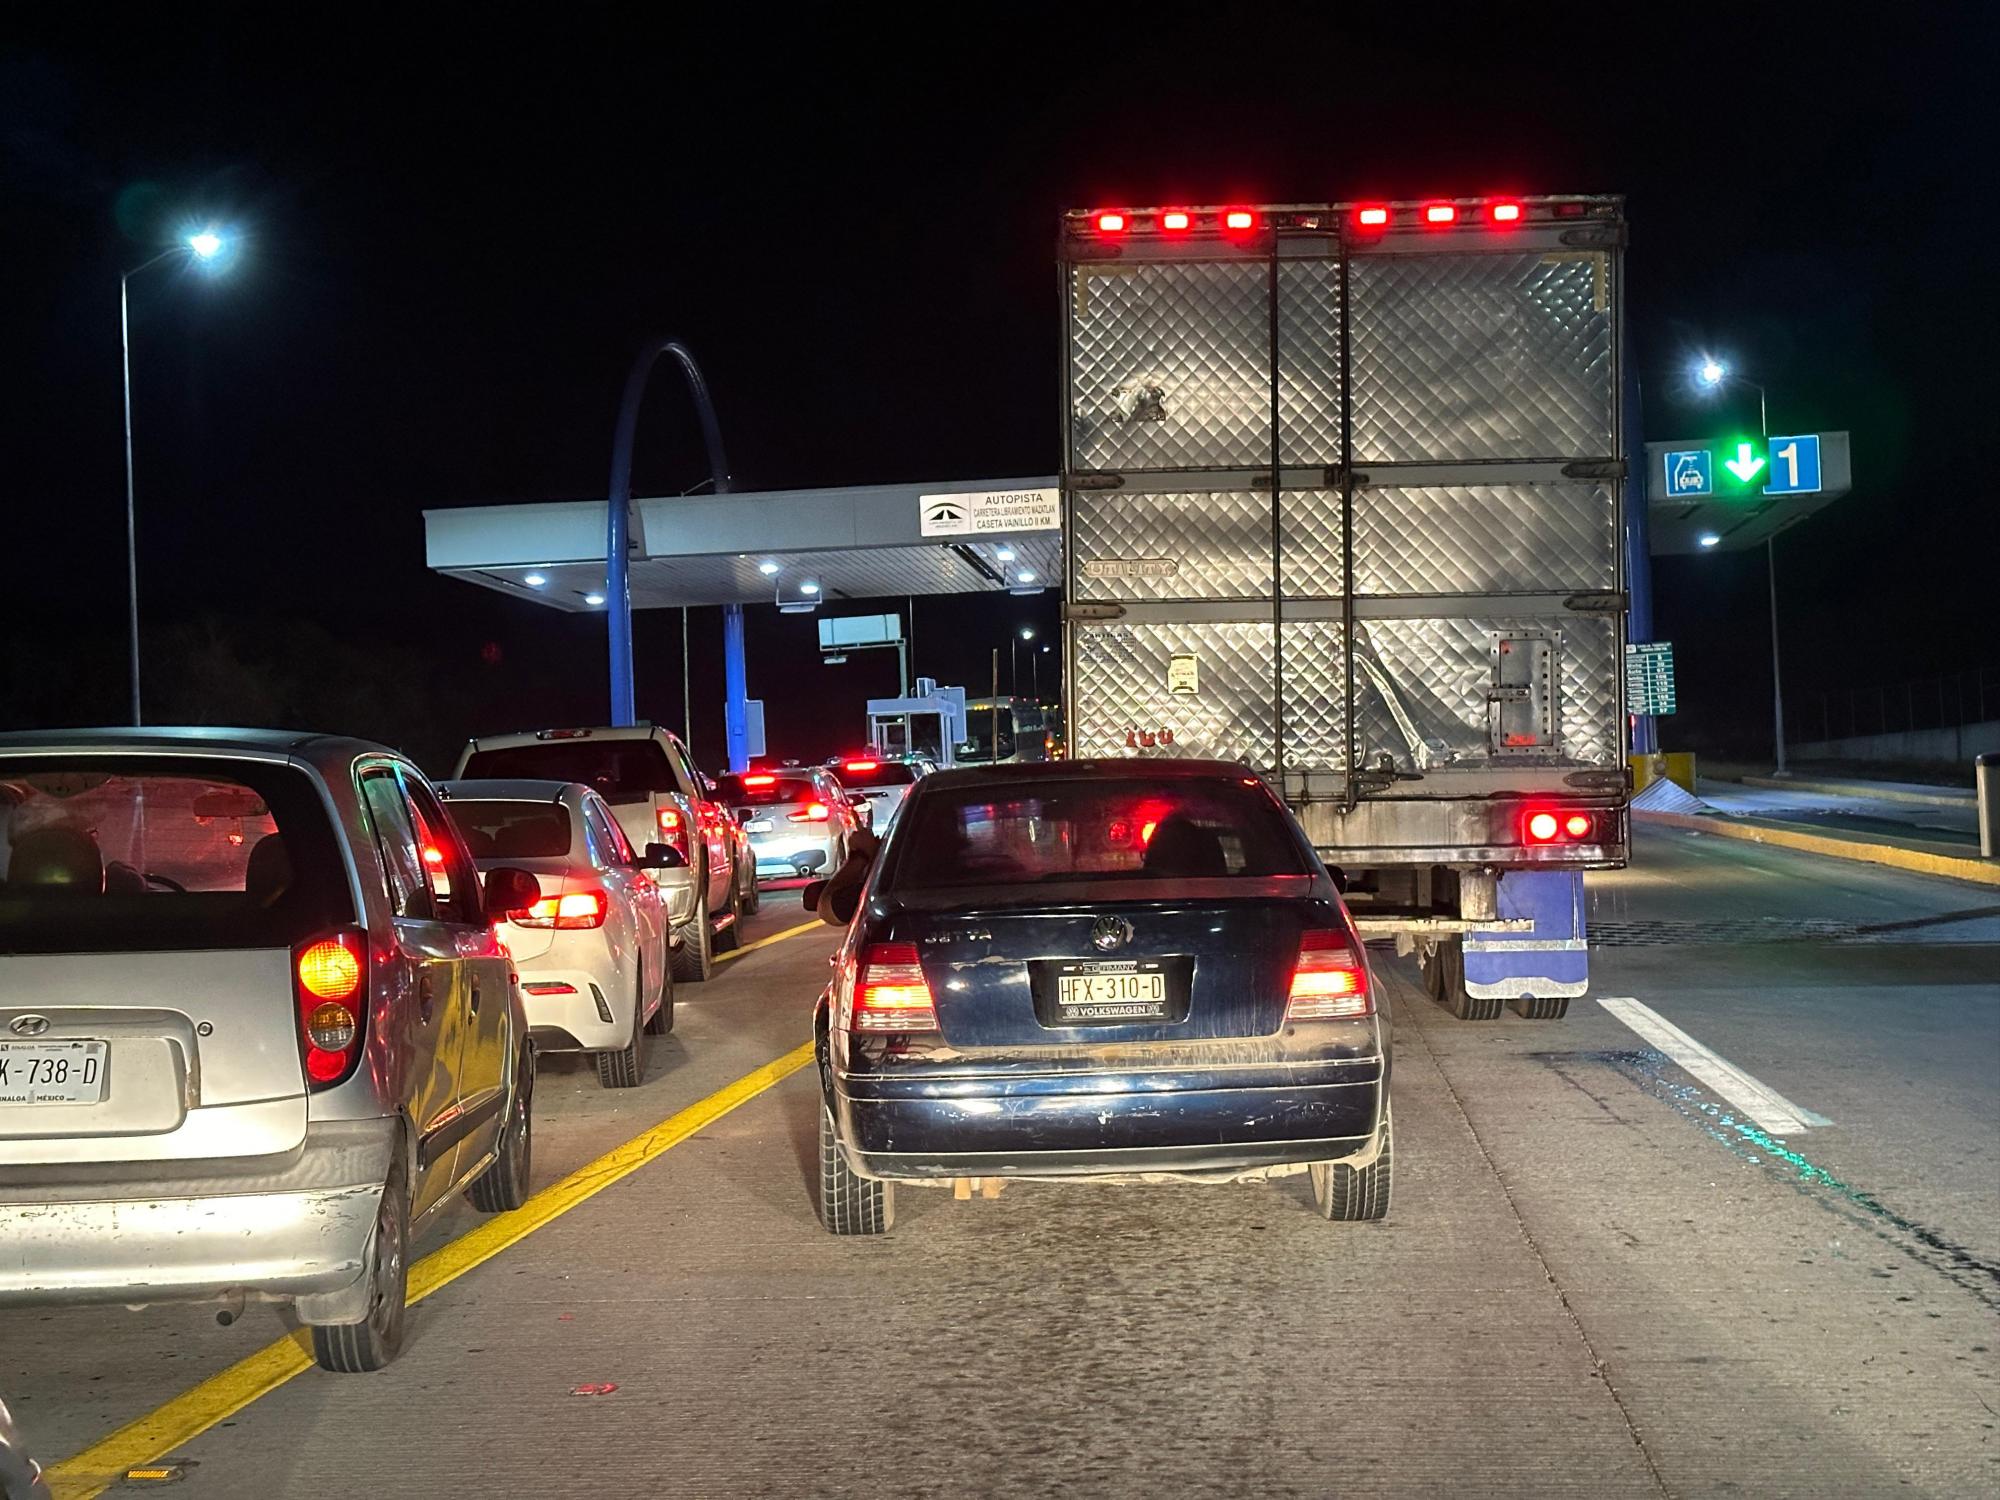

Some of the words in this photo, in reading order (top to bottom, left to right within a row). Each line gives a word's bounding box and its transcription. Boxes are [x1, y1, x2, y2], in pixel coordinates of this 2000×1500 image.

[1778, 442, 1799, 487] 1
[985, 493, 1043, 505] AUTOPISTA
[976, 519, 1003, 529] CASETA
[1003, 516, 1033, 528] VAINILLO
[1060, 976, 1161, 1002] HFX-310-D
[1080, 1005, 1146, 1016] VOLKSWAGEN
